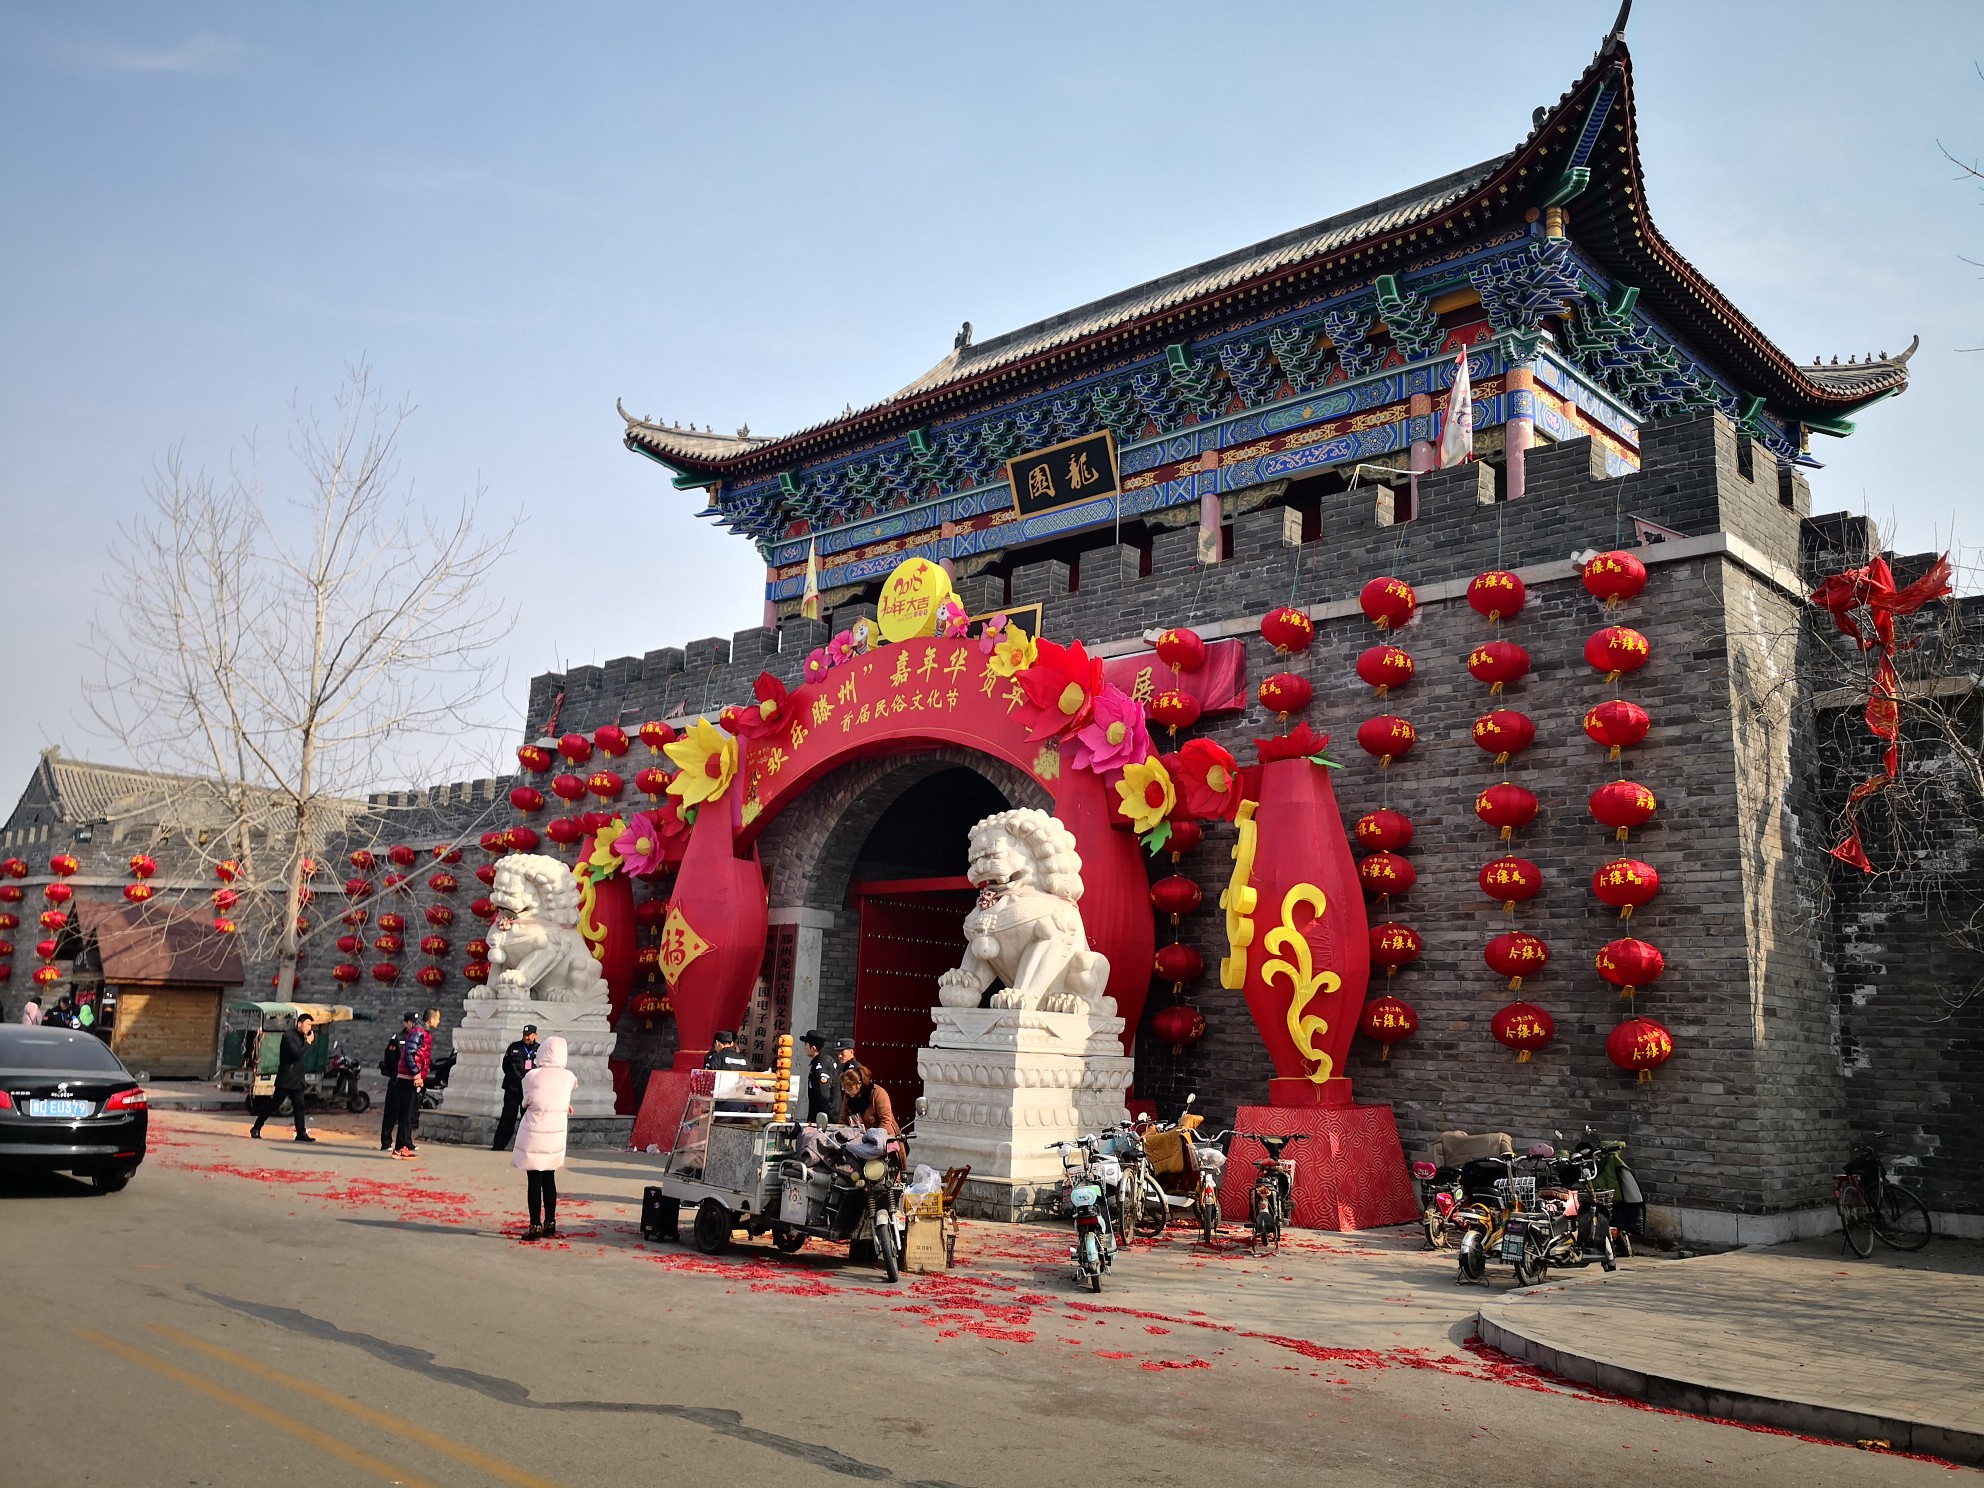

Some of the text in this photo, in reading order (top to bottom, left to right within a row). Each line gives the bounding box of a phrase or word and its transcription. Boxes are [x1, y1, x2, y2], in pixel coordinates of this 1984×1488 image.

[1131, 666, 1155, 707] 展
[840, 688, 959, 733] 首届民俗文化节
[661, 928, 685, 966] 福
